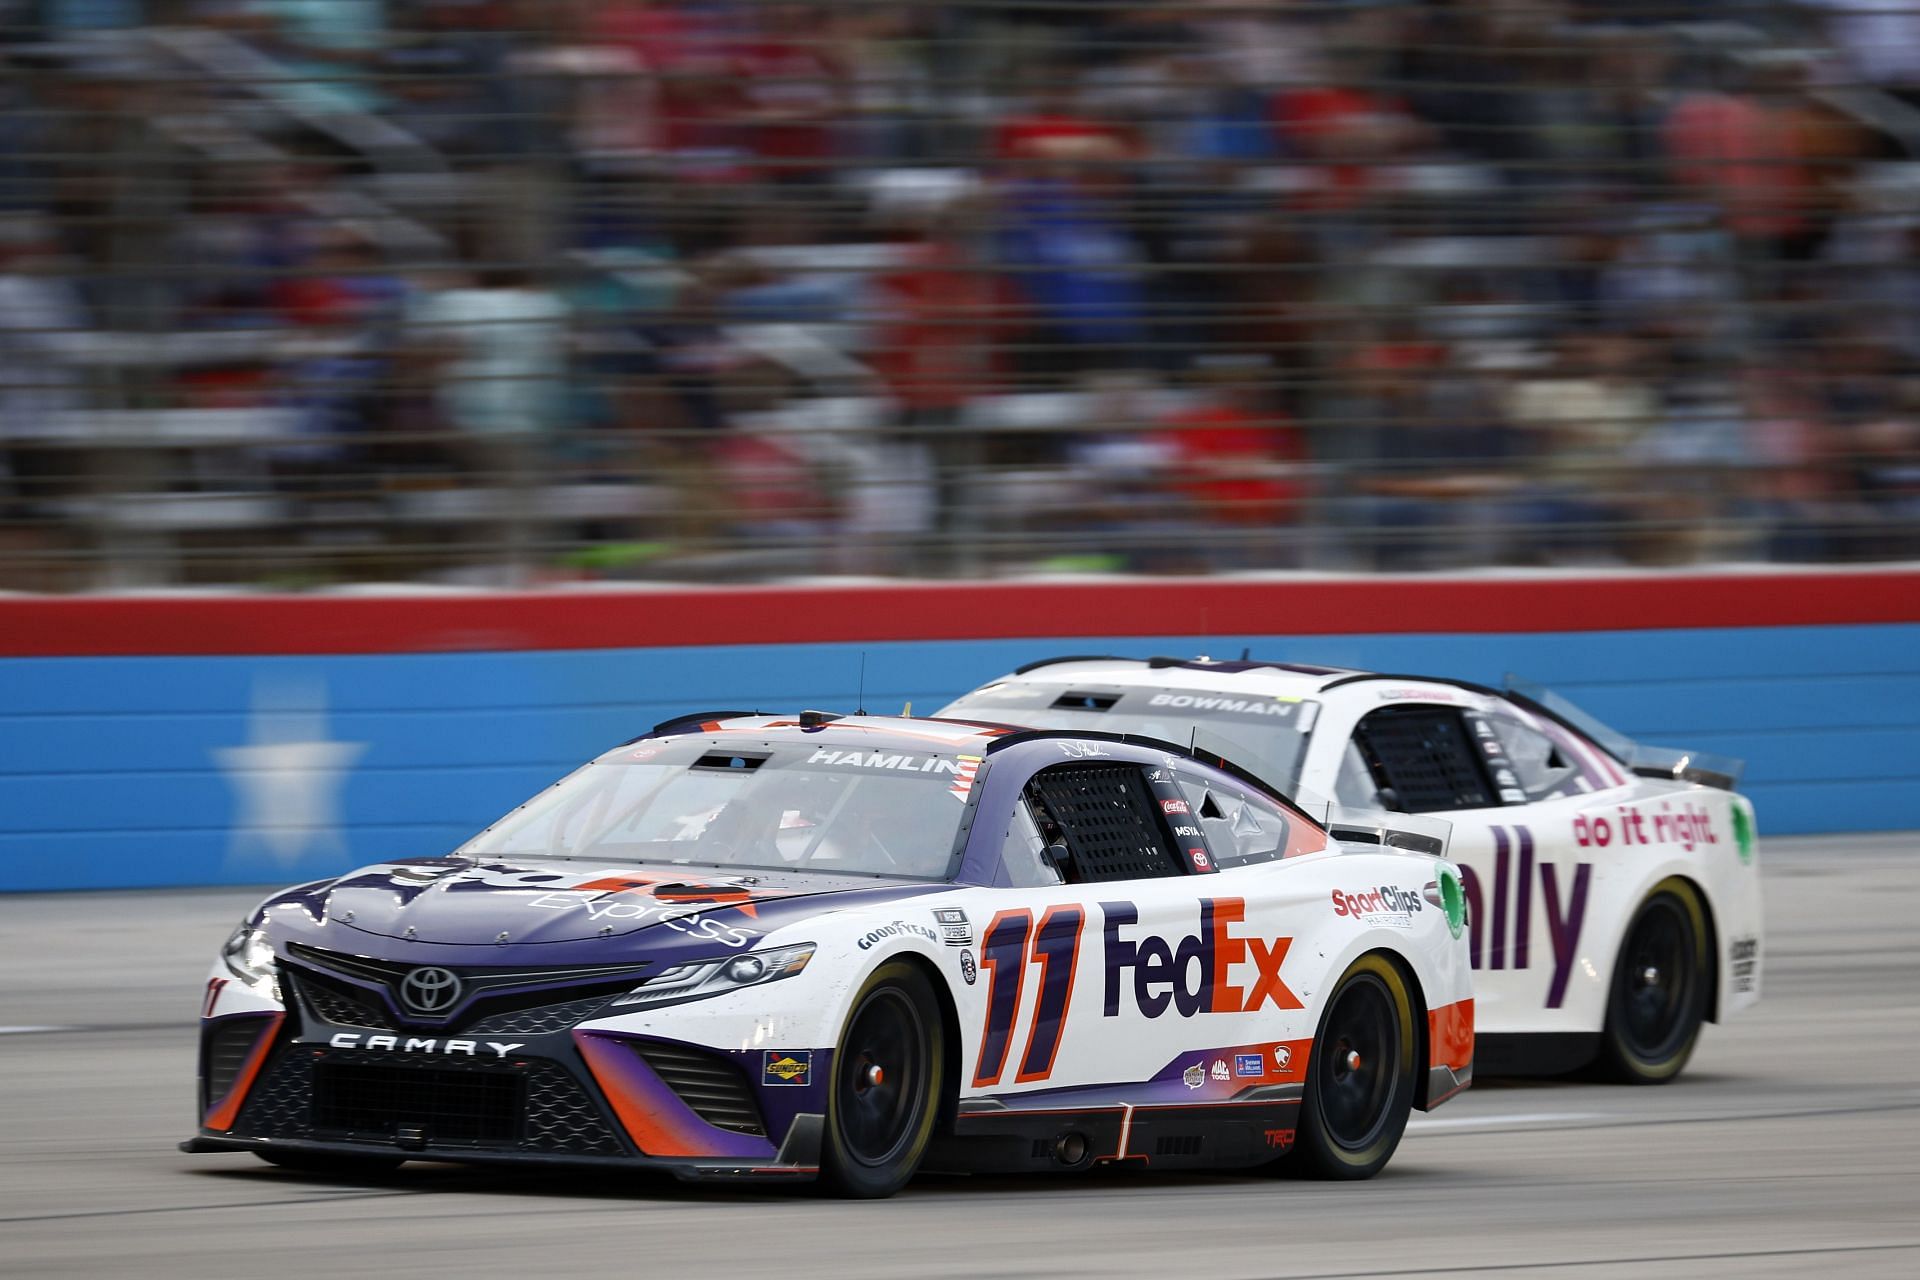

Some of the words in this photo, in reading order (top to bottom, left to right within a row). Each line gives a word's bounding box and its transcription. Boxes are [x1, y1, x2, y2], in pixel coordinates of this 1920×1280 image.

[1149, 693, 1291, 716] BOWMAN
[807, 750, 962, 775] HAMLIN
[1175, 826, 1200, 837] MSYA
[1573, 813, 1612, 847] do
[1618, 805, 1649, 845] it
[527, 890, 757, 948] Express
[857, 920, 938, 950] GOODYEAR
[1097, 896, 1306, 1019] FedEx
[971, 903, 1085, 1089] 11
[329, 1033, 526, 1058] CAMRY
[767, 1063, 808, 1074] SUNOCO
[1211, 1059, 1230, 1075] MAC
[1264, 1128, 1297, 1149] TRD
